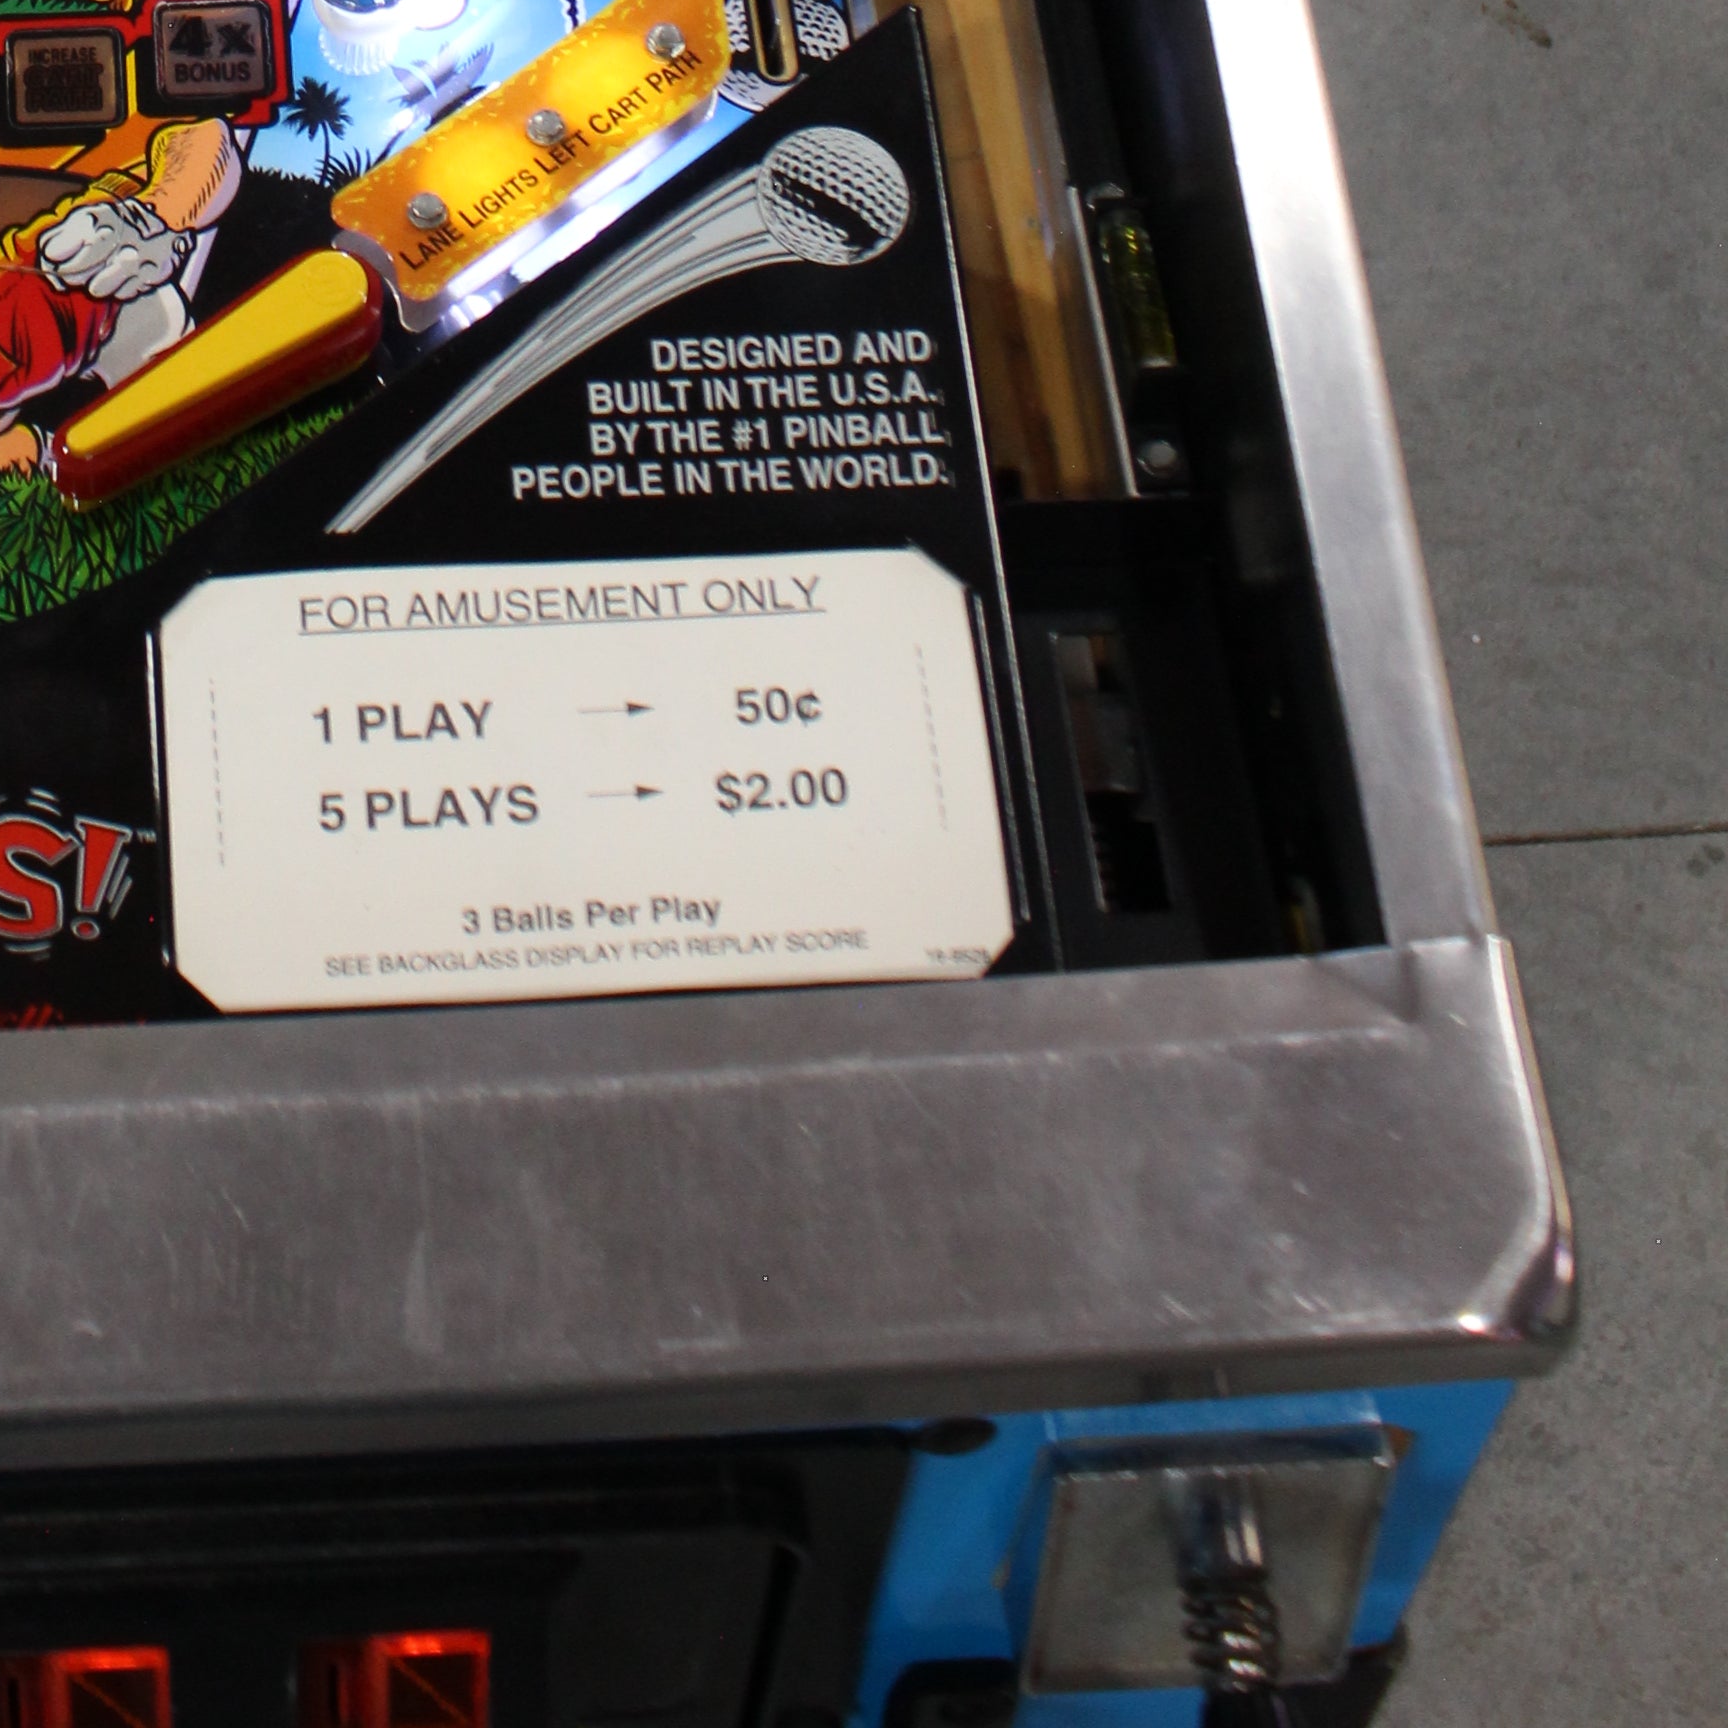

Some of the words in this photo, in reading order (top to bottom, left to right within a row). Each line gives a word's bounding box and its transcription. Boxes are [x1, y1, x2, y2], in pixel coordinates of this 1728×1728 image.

[172, 59, 251, 85] BONUS
[398, 225, 462, 273] LANE
[456, 167, 540, 230] LIGHTS
[535, 130, 595, 178] LEFT
[588, 89, 651, 136] CART
[644, 48, 704, 96] PATH
[651, 338, 843, 373] DESIGNED
[852, 329, 933, 362] AND
[587, 380, 694, 416] BUILT
[703, 378, 741, 411] IN
[745, 374, 821, 409] THE
[829, 372, 938, 405] U.S.A.
[589, 421, 642, 457] BY
[645, 418, 723, 454] THE
[731, 418, 770, 450] #1
[785, 412, 944, 448] PINBALL
[511, 465, 666, 501] PEOPLE
[674, 462, 714, 495] IN
[717, 459, 795, 494] THE
[800, 455, 950, 491] WORLD.
[300, 596, 391, 632] FOR
[406, 582, 688, 626] AMUSEMENT
[703, 576, 821, 612] ONLY
[313, 707, 334, 744] 1
[358, 701, 494, 742] PLAY
[737, 686, 822, 726] 50¢
[319, 794, 344, 831] 5
[365, 784, 540, 829] PLAYS
[716, 768, 849, 814] $2.00
[462, 909, 482, 934] 3
[493, 903, 575, 934] Balls
[586, 901, 640, 929] Per
[650, 896, 722, 931] Play
[325, 956, 373, 977] SEE
[378, 948, 520, 975] BACKGLASS
[525, 944, 624, 968] DISPLAY
[687, 934, 777, 957] REPLAY
[785, 928, 870, 952] SCORE
